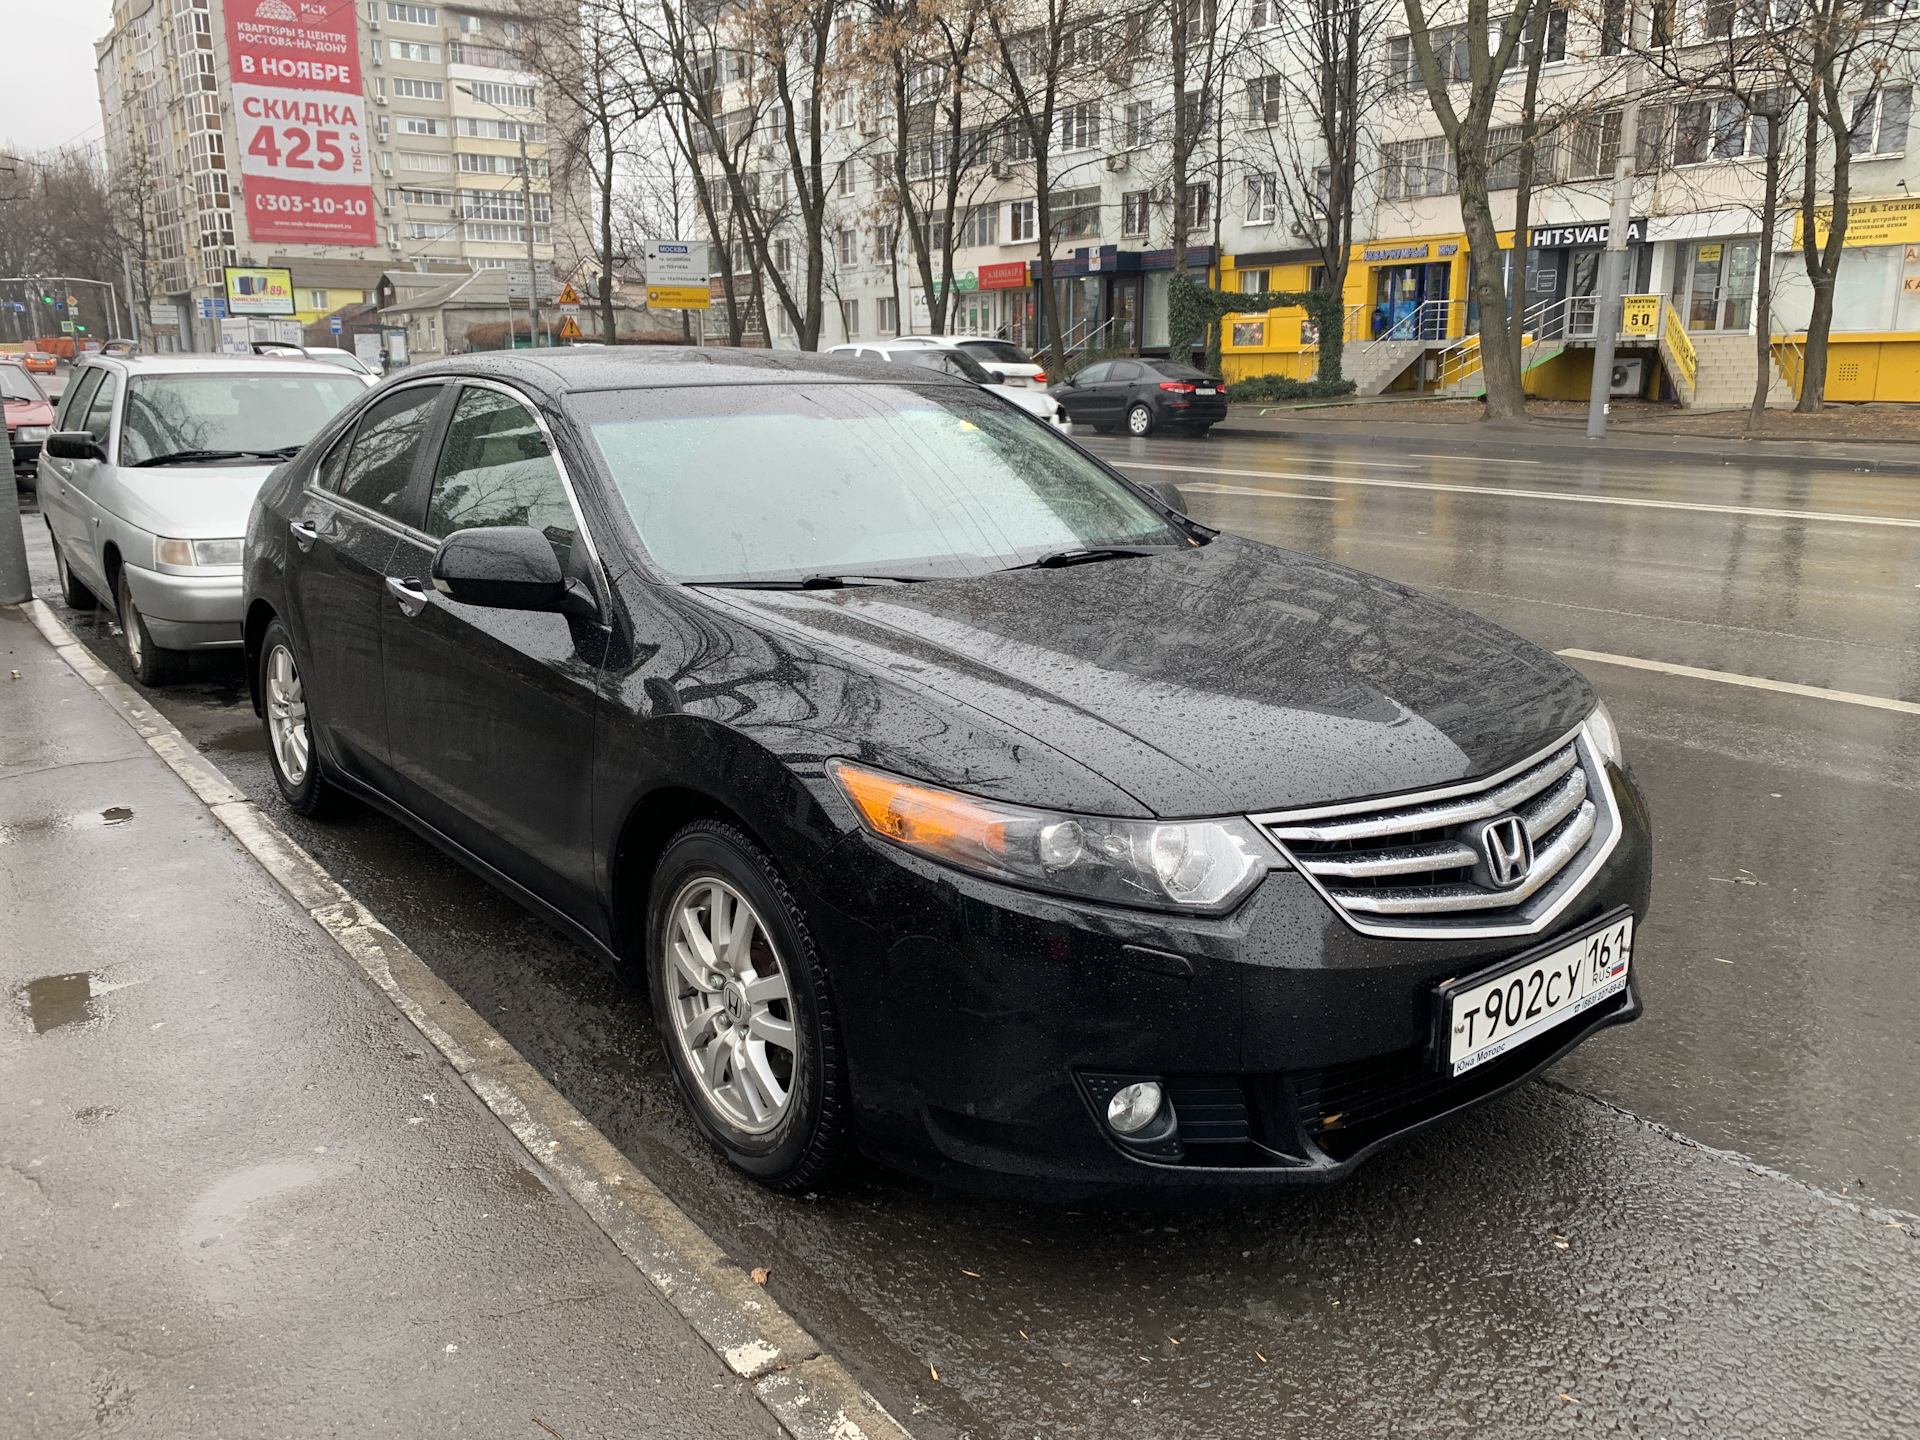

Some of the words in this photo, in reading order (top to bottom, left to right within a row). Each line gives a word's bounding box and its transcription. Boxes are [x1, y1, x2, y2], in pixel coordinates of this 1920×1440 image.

[300, 3, 328, 15] МСК
[237, 22, 296, 37] КВАРТИРЫ
[298, 28, 305, 38] В
[306, 30, 347, 43] ЦЕНТРЕ
[238, 32, 347, 53] РОСТОВА-НА-ДОНУ
[240, 54, 256, 73] В
[261, 57, 351, 83] НОЯБРЕ
[242, 96, 358, 127] СКИДКА
[248, 125, 345, 171] 425
[265, 194, 367, 216] 303-10-10
[1870, 205, 1877, 213] &
[1872, 216, 1907, 224] устройств
[1534, 224, 1640, 247] HITSVADA
[1438, 245, 1457, 255] МИР
[1631, 313, 1650, 326] 50
[1464, 959, 1581, 1047] Т902СУ
[1588, 925, 1625, 973] 161
[1592, 967, 1610, 986] RUS
[1456, 1058, 1475, 1072] Юна
[1476, 1043, 1506, 1063] Моторс
